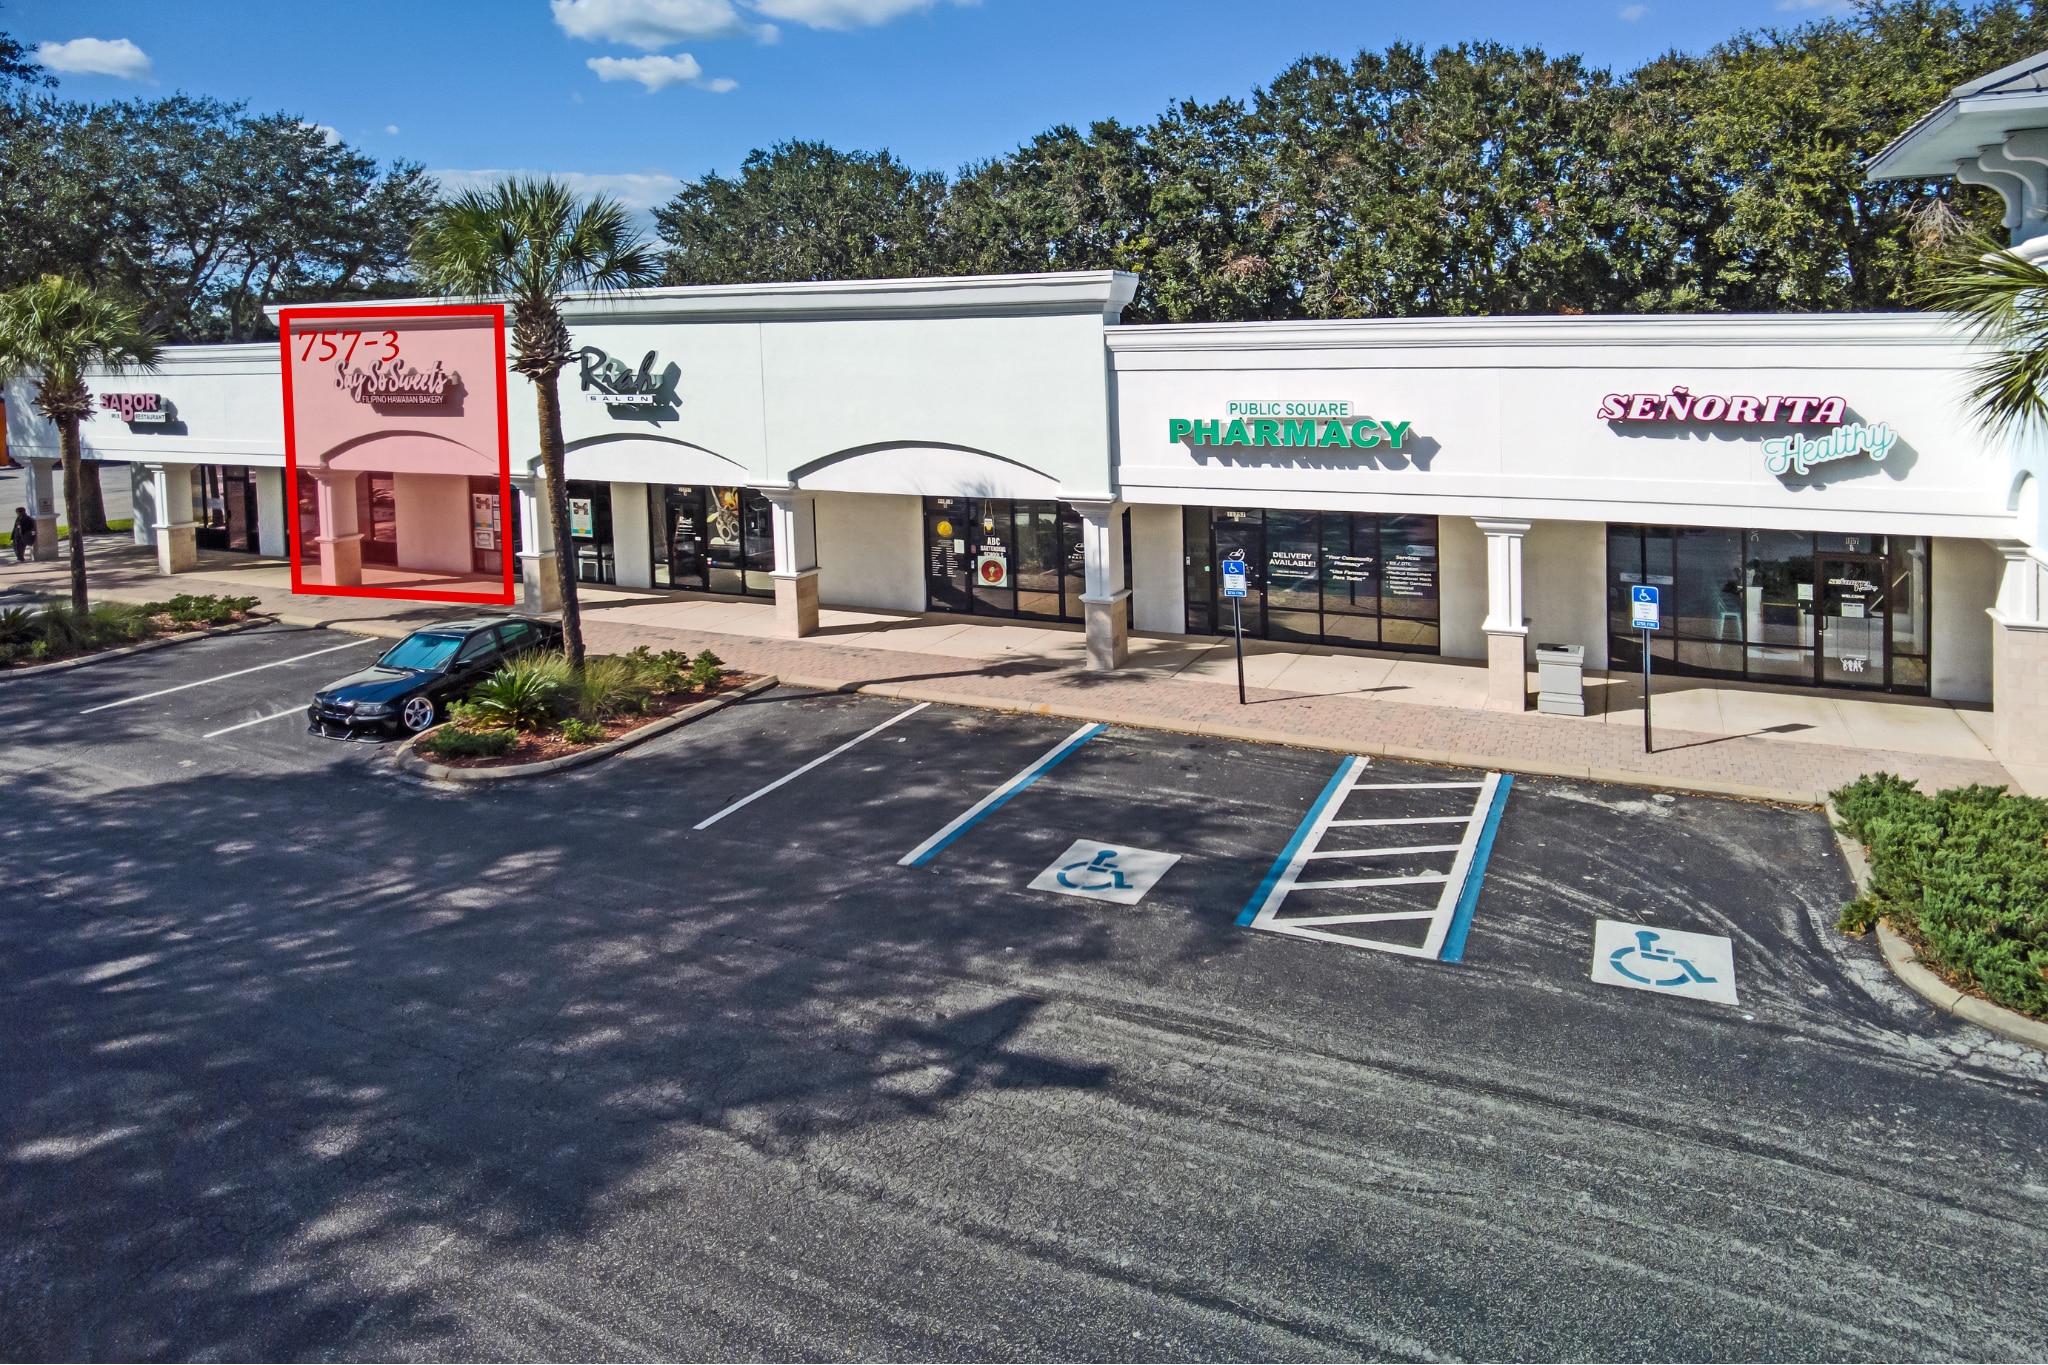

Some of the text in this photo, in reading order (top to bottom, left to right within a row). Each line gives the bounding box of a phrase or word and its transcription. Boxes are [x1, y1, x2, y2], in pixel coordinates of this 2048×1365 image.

[334, 359, 368, 402] Say
[367, 359, 388, 393] So
[580, 346, 657, 410] Riah
[100, 393, 157, 421] SABOR
[362, 395, 443, 404] FILIPINO HAWAIIAN BAKERY
[1229, 402, 1349, 416] PUBLIC SQUARE
[1597, 385, 1847, 424] SEÑORITA
[1169, 418, 1412, 449] PHARMACY
[1761, 422, 1898, 476] Healthy
[987, 537, 1001, 546] ABC
[1272, 551, 1312, 560] DELIVERY
[1269, 558, 1317, 567] AVAILABLE!
